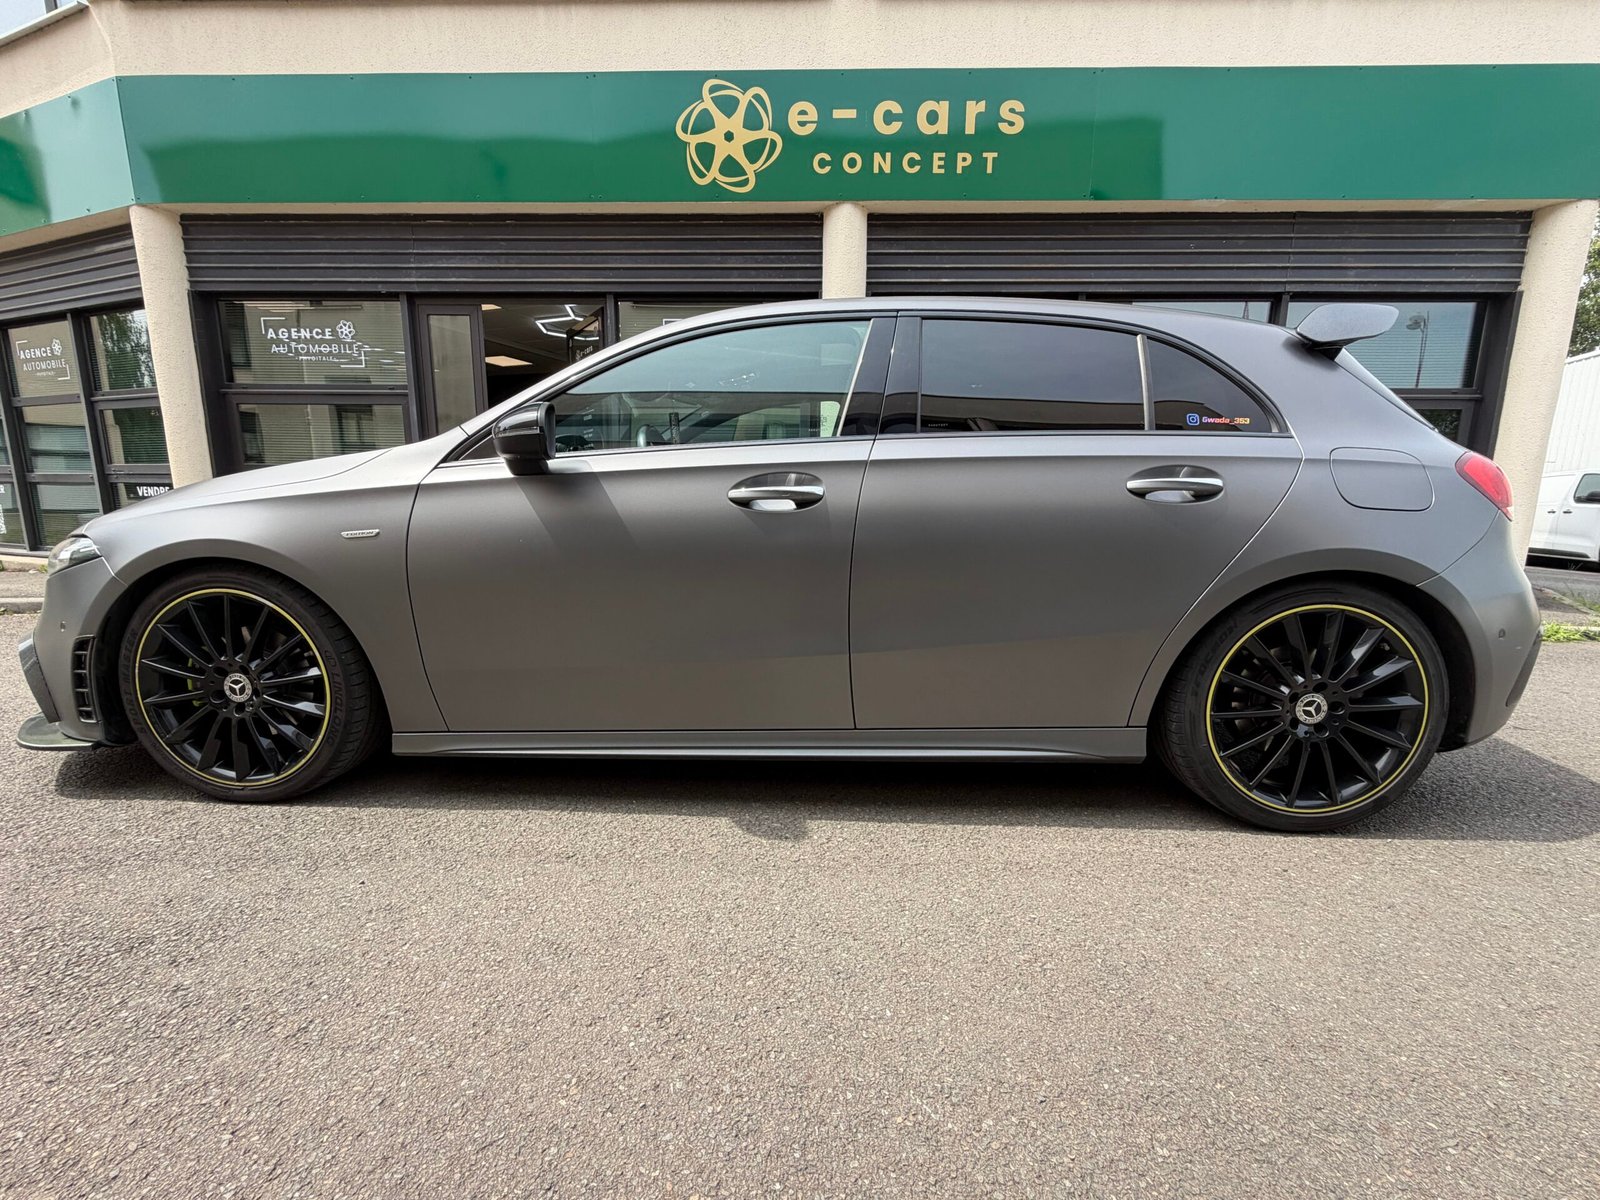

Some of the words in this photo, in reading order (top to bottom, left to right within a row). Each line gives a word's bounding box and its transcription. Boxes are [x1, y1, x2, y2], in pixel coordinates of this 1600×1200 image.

[787, 99, 1025, 135] e-cars
[812, 152, 999, 174] CONCEPT
[267, 328, 332, 339] AGENCE
[20, 346, 52, 359] AGENCE
[271, 343, 359, 354] AUTOMOBILE
[23, 359, 66, 371] AUTOMOBILE
